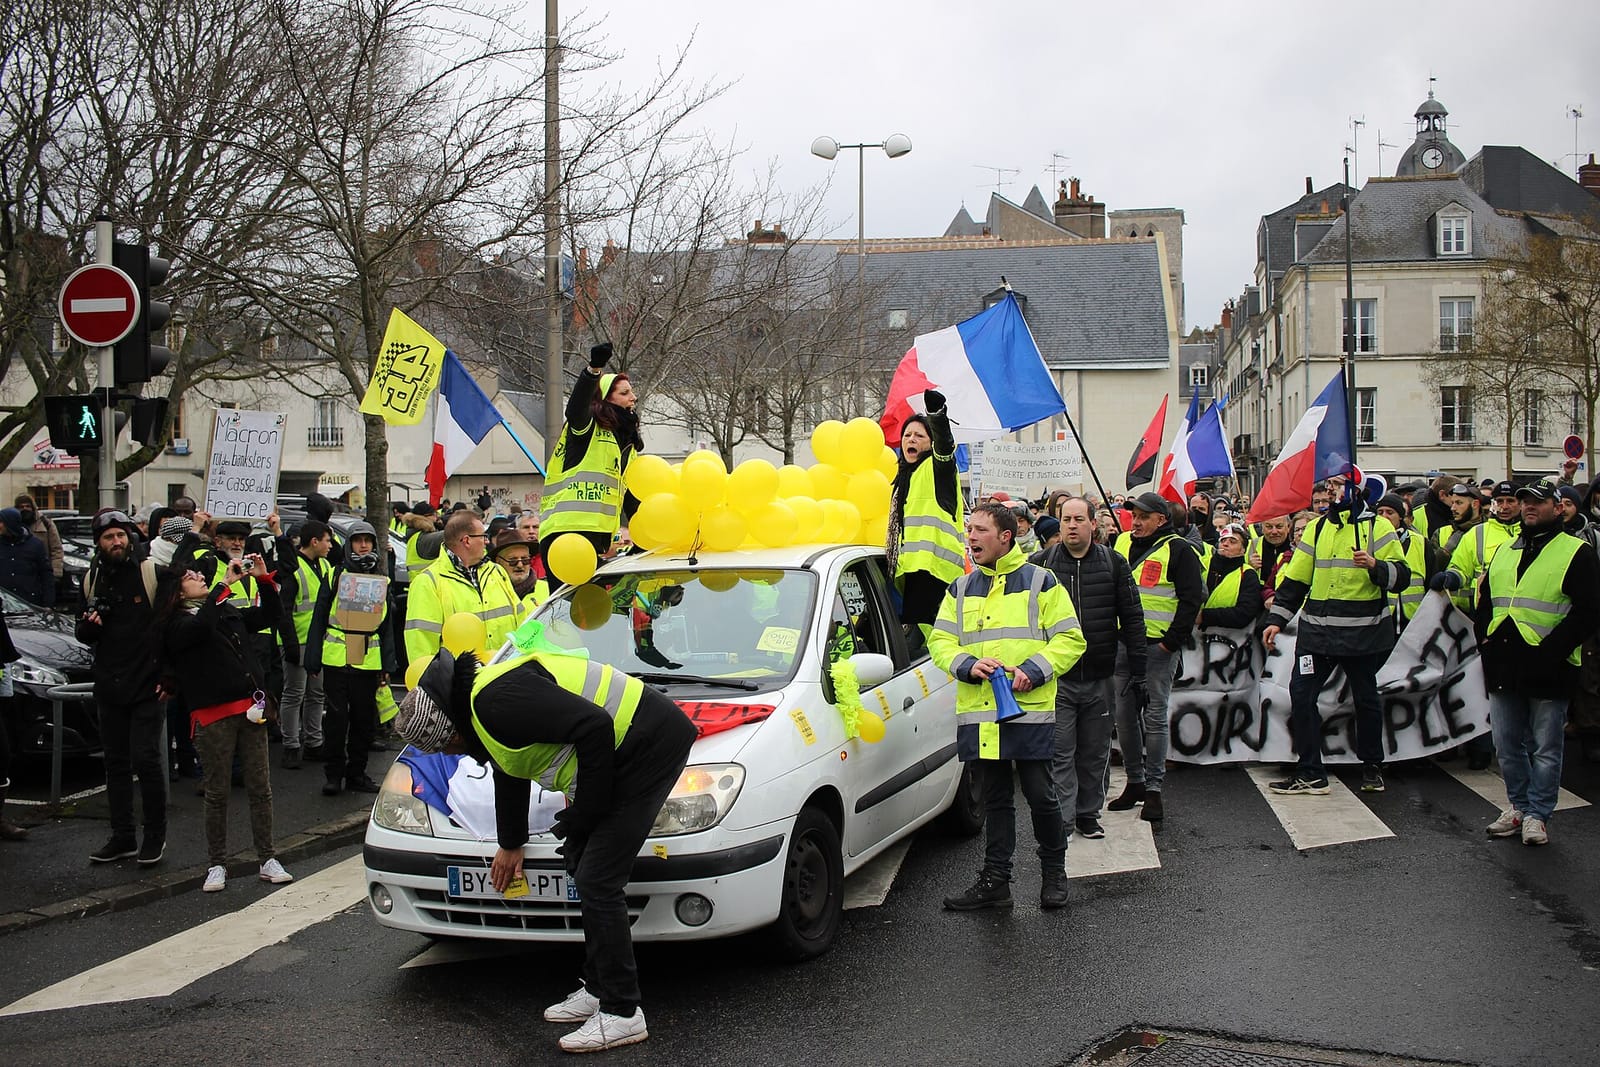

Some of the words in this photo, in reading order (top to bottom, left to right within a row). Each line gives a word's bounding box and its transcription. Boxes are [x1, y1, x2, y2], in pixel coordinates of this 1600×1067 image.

[215, 415, 278, 445] Macron
[1003, 445, 1011, 453] NE
[1002, 458, 1016, 468] NOUS
[320, 475, 350, 485] HALLES
[1027, 471, 1035, 479] ET
[1036, 471, 1061, 479] JUSTICE
[567, 481, 579, 490] ON
[576, 490, 601, 500] RIEN
[206, 489, 269, 518] France
